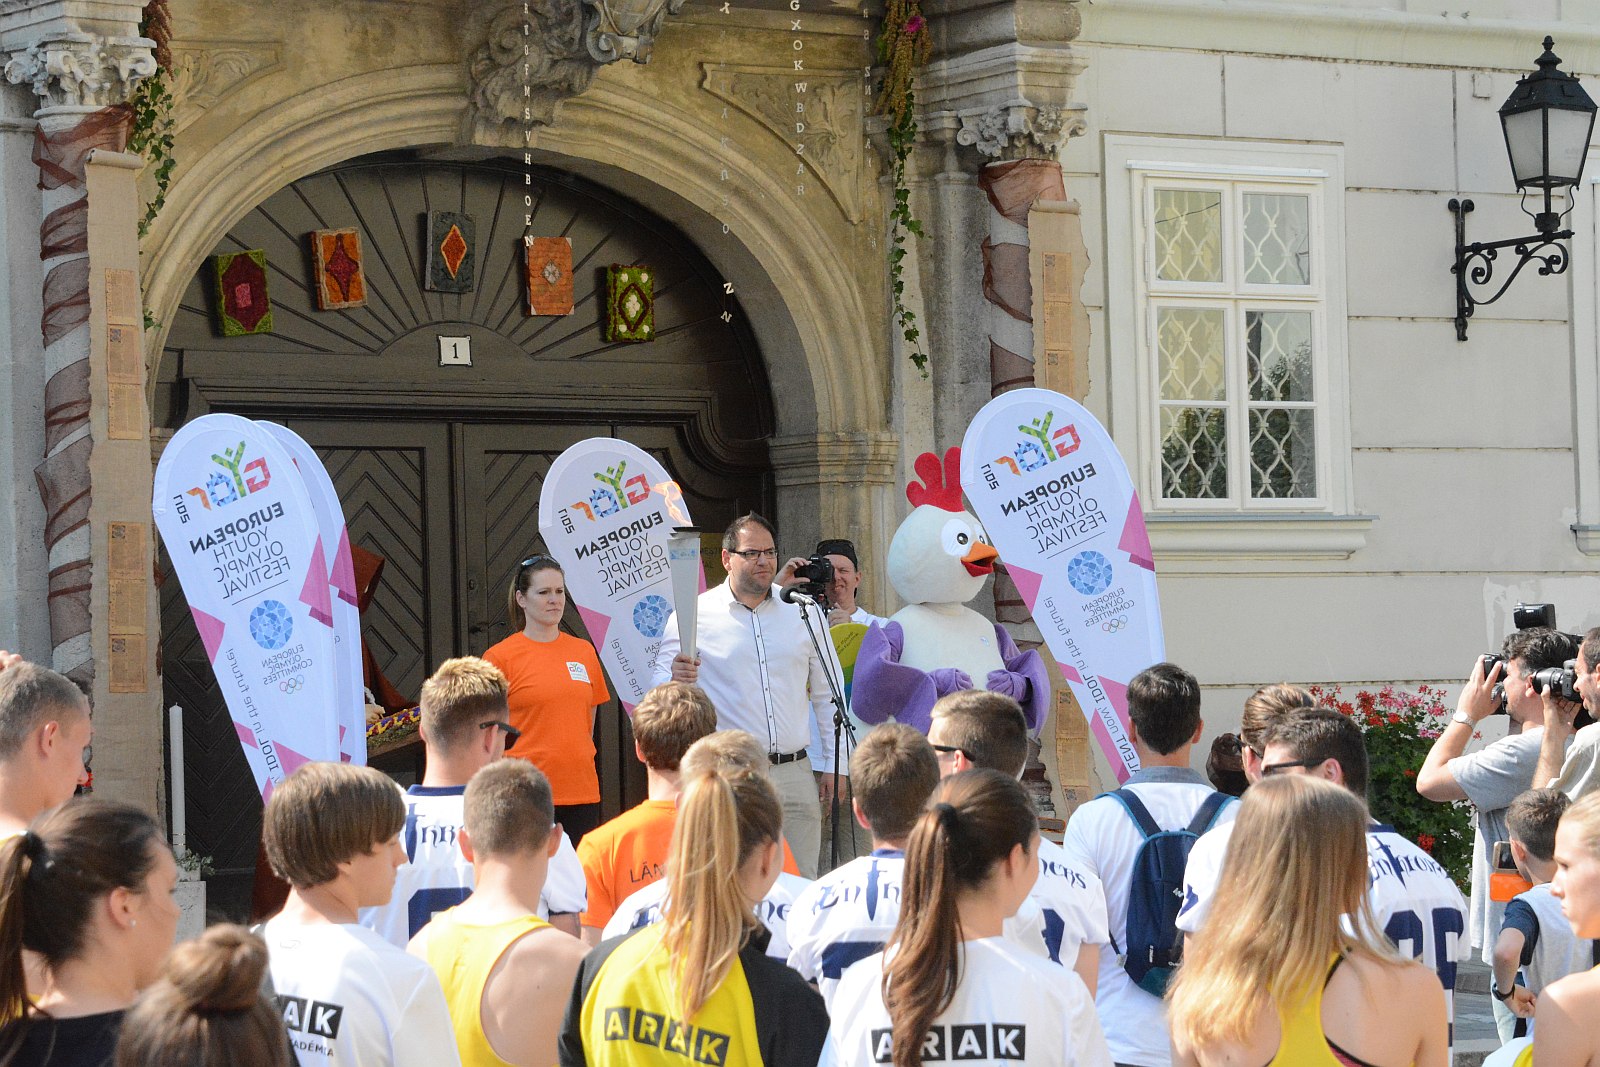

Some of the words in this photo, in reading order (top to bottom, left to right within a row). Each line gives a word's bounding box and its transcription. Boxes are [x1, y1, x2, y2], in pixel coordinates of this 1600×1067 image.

[452, 342, 459, 359] 1
[606, 1010, 724, 1064] ARAK
[875, 1028, 1020, 1060] ARAK
